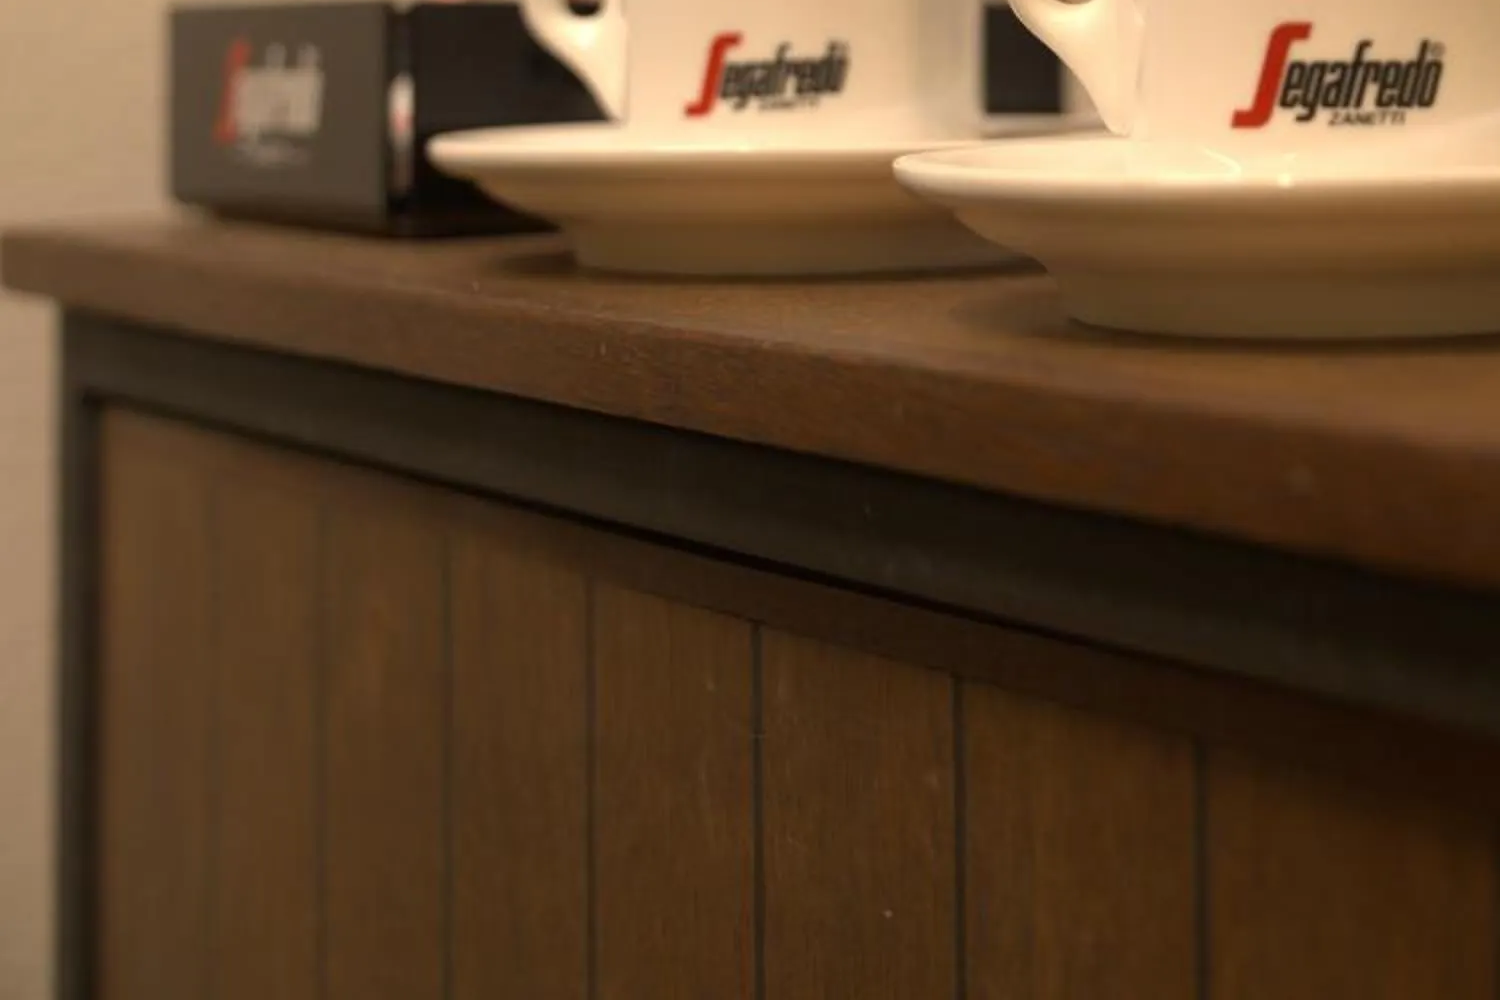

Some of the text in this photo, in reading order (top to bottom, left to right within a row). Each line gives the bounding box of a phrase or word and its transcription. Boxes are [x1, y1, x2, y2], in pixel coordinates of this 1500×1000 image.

[685, 33, 849, 116] Segafredo
[1231, 22, 1443, 128] Segafredo
[1328, 111, 1406, 126] ZANETTI
